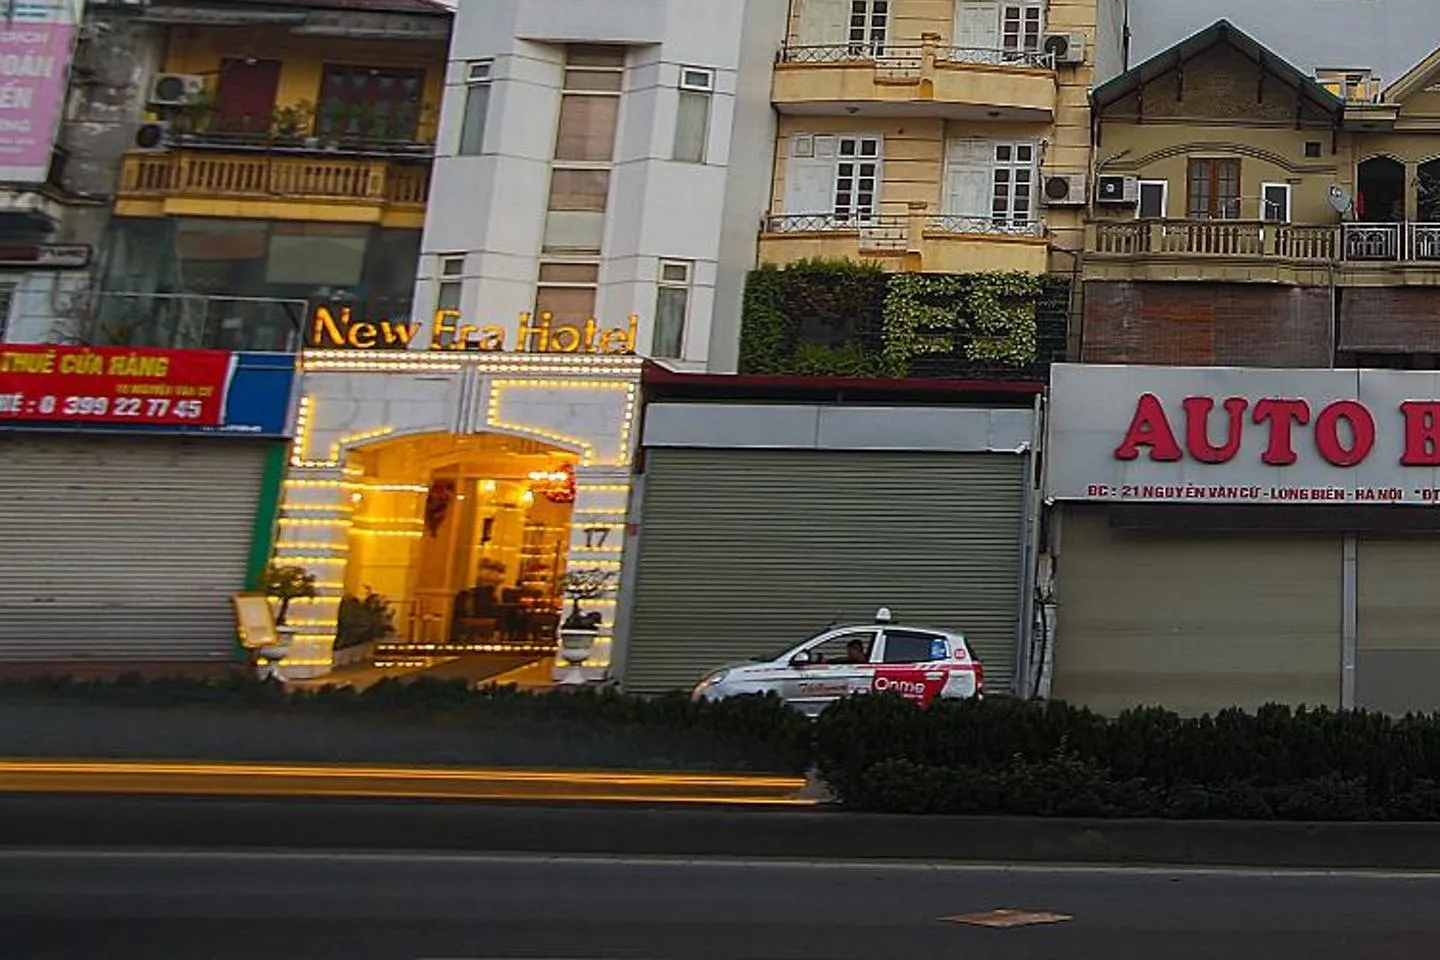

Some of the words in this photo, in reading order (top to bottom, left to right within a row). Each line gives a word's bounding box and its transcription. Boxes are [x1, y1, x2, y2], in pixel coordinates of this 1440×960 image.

[313, 307, 423, 348] New
[431, 308, 505, 350] Era
[516, 311, 638, 353] Hotel
[112, 397, 141, 416] 22
[146, 398, 171, 417] 77
[1114, 393, 1376, 467] AUTO
[1121, 485, 1140, 497] 21
[1271, 487, 1308, 500] LONG
[583, 527, 611, 548] 17
